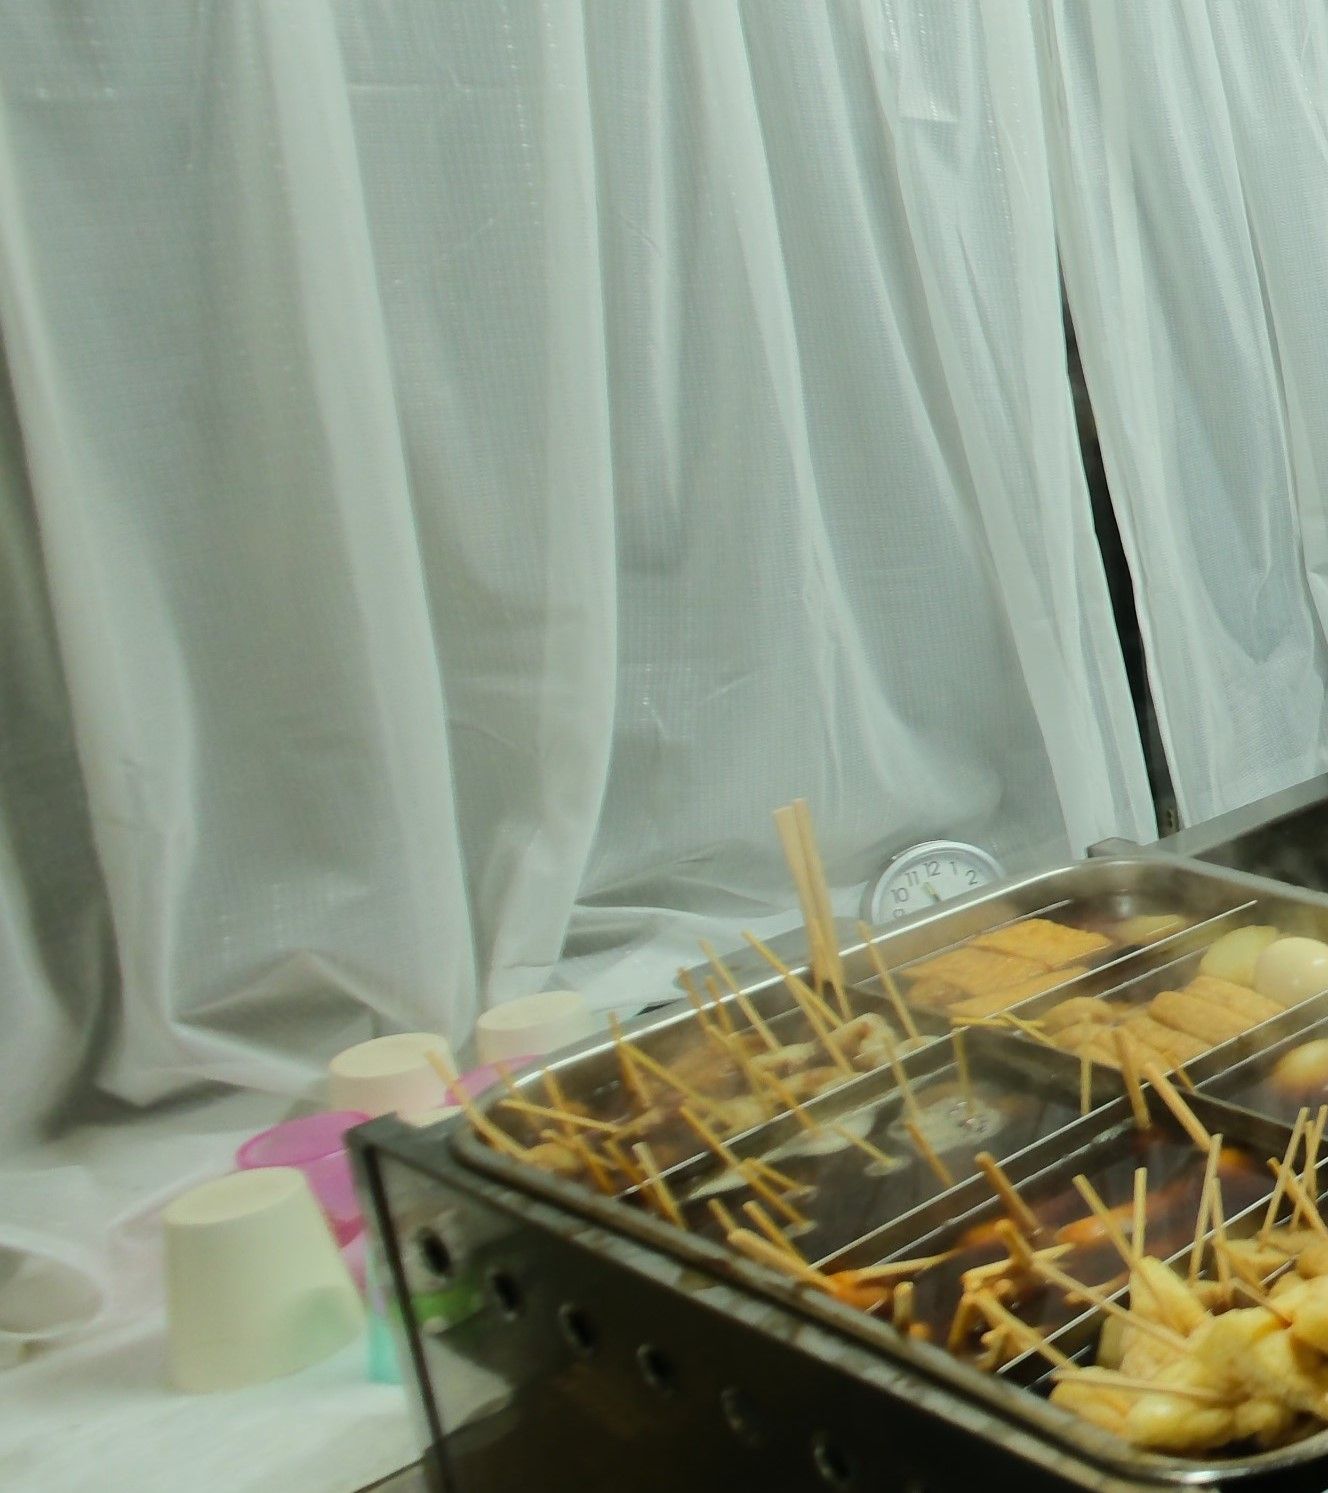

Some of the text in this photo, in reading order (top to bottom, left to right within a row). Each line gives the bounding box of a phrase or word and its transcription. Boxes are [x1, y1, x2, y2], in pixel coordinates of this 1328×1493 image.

[924, 861, 941, 877] 12
[950, 861, 957, 875] 1
[906, 871, 920, 887] 11
[966, 870, 978, 886] 2
[891, 887, 908, 904] 10
